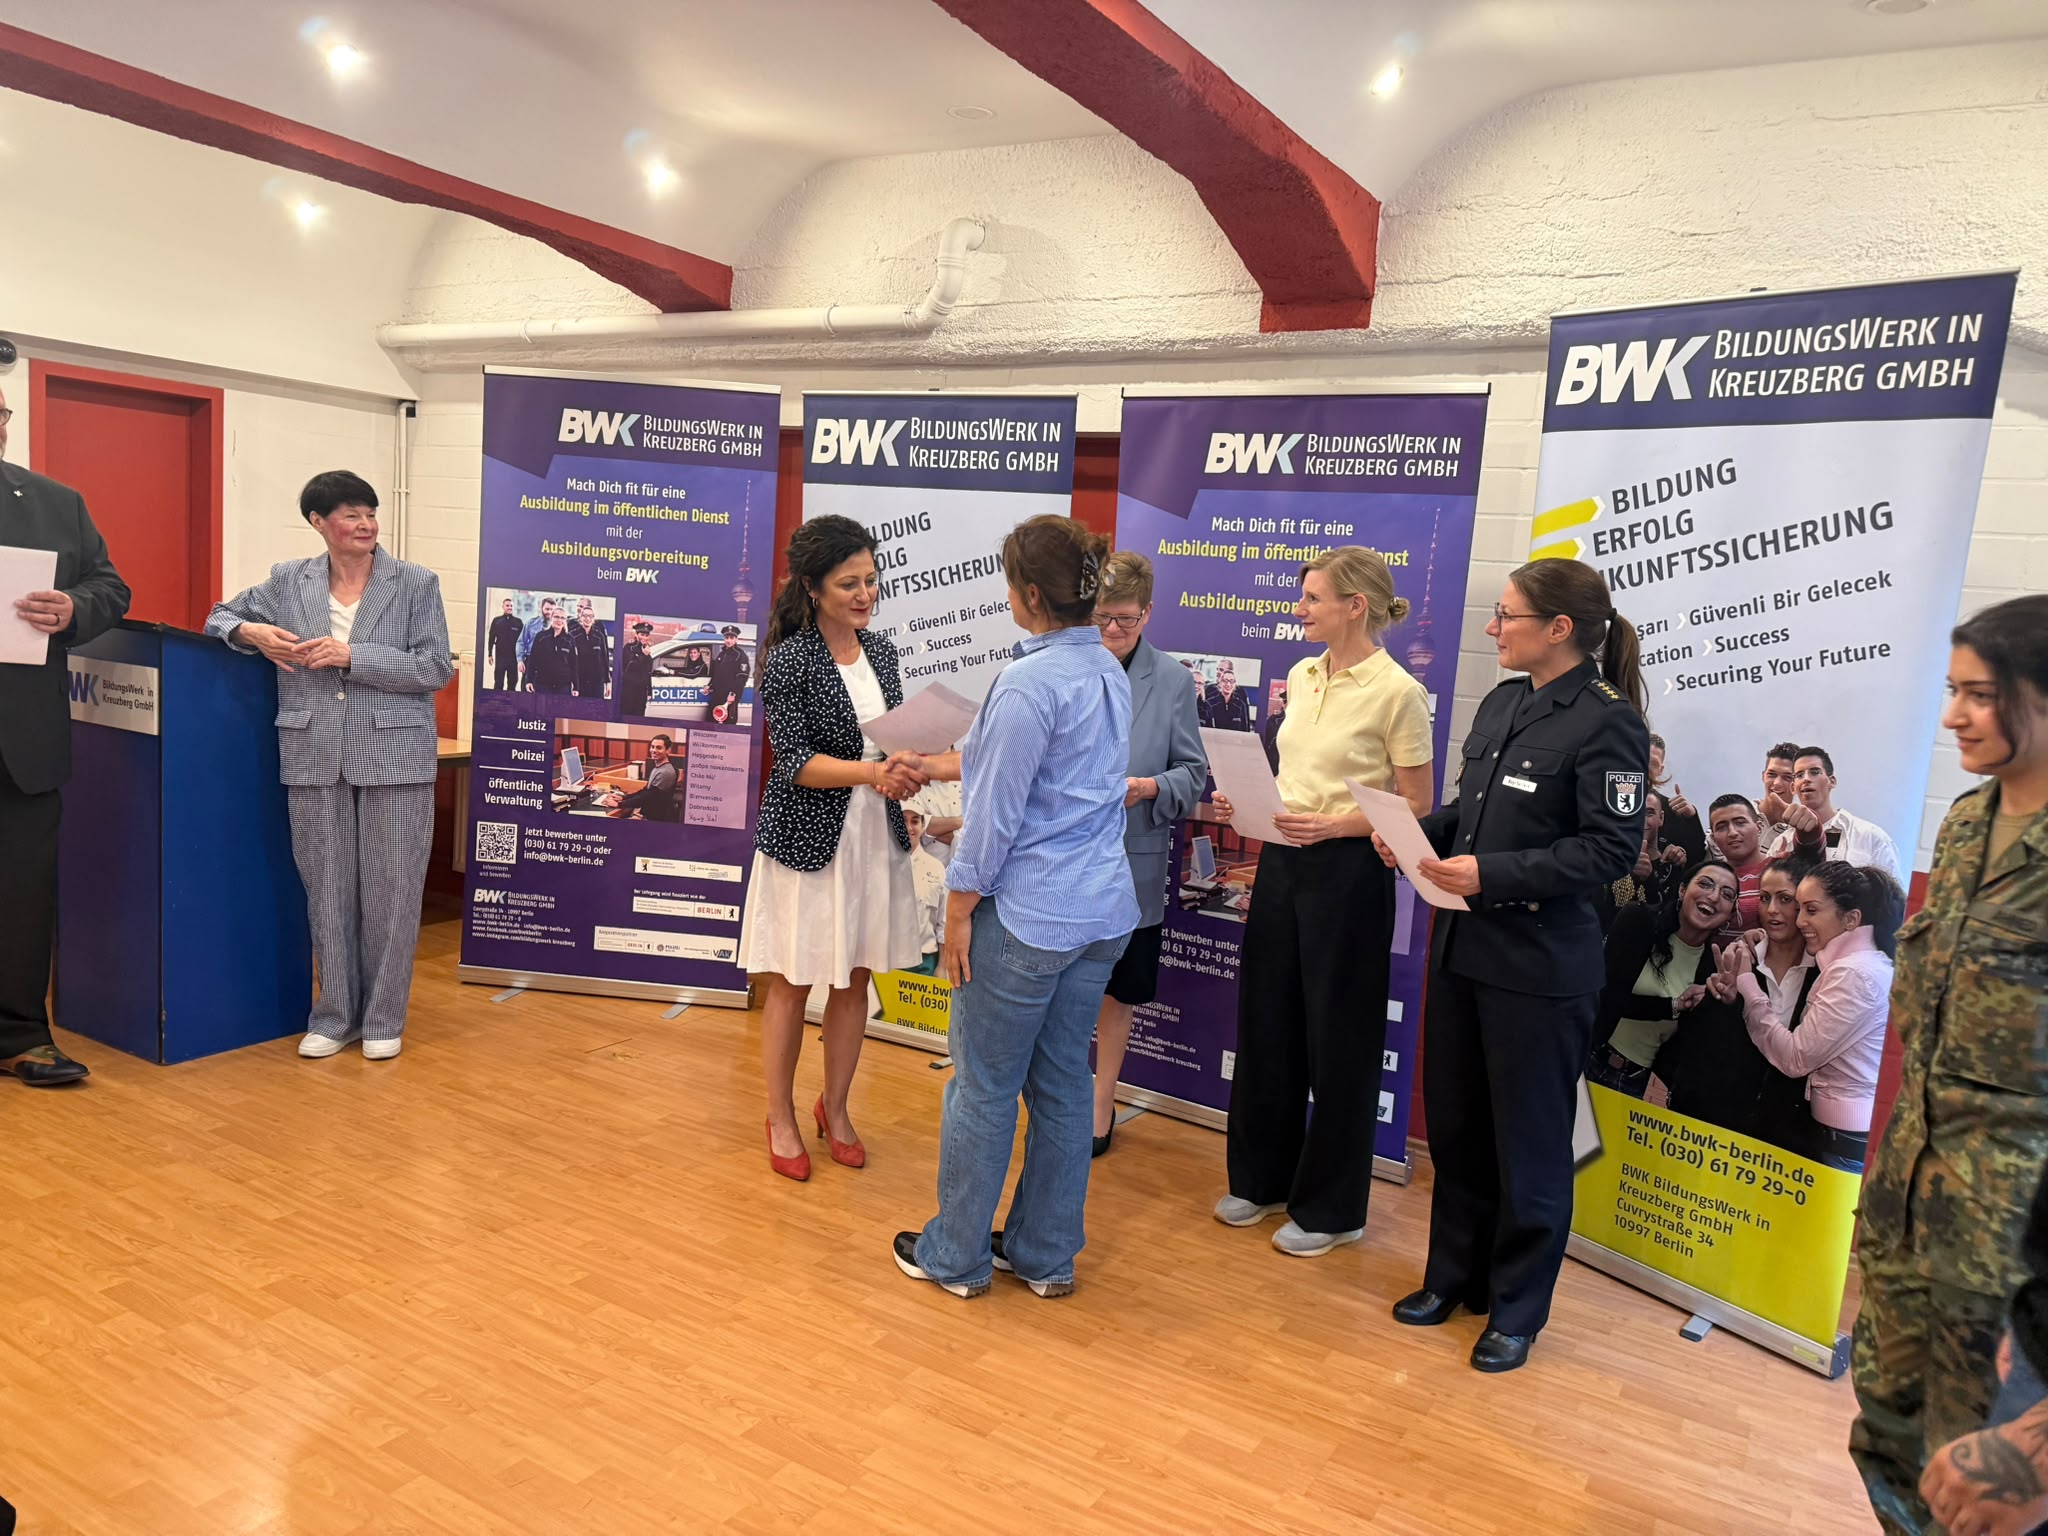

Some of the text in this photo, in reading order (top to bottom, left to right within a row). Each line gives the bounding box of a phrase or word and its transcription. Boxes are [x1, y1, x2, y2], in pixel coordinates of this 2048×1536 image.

[1946, 314, 1983, 344] IN
[1555, 335, 1712, 406] BWK
[558, 408, 641, 447] BWK
[749, 426, 763, 440] IN
[1043, 423, 1061, 443] IN
[811, 418, 908, 467] BWK
[1204, 432, 1305, 475] BWK
[1442, 437, 1461, 455] IN
[567, 478, 686, 500] Mach Dich fit für eine
[1612, 458, 1737, 515] BILDUNG
[520, 495, 730, 525] Ausbildung im öffentlichen Dienst
[606, 525, 643, 540] mit der
[871, 511, 931, 543] LDUNG
[1212, 516, 1354, 536] Mach Dich fit für eine
[1592, 509, 1694, 557] ERFOLG
[541, 540, 709, 570] Ausbildungsvorbereitung
[1158, 538, 1237, 562] Ausbildung
[1241, 543, 1259, 560] im
[1599, 501, 1894, 592] KUNFTSSICHERUNG
[875, 547, 908, 572] OLG
[597, 567, 659, 584] beim BWK
[1255, 571, 1298, 588] mit der
[1179, 591, 1300, 616] Ausbildungsvor
[1637, 570, 1893, 641] şarı Güvenli Bir Gelecek
[909, 610, 956, 632] Güvenli
[960, 608, 976, 622] Bir
[979, 601, 1010, 617] Gelec
[926, 633, 972, 652] Success
[1241, 622, 1306, 641] beim BW
[1639, 626, 1790, 667] cation Success
[904, 647, 1013, 679] Securing Your Futu
[1675, 643, 1891, 691] Securing Your Future
[69, 671, 99, 707] WK
[103, 680, 154, 697] BildungsWerk in
[652, 689, 698, 700] POLIZEI
[102, 694, 154, 713] Kreuzberg GmbH
[517, 718, 547, 731] Justiz
[511, 749, 545, 762] Polizei
[488, 777, 544, 793] öffentliche
[1609, 775, 1642, 783] POLIZEI
[484, 793, 543, 810] Verwaltung
[524, 827, 607, 843] Jetzt bewerben unter
[524, 838, 545, 849] (030)
[547, 840, 556, 850] 61
[559, 841, 569, 851] 79
[594, 845, 612, 855] oder
[524, 850, 604, 867] info@bwk-berlin.de
[473, 888, 507, 905] BWK
[697, 907, 721, 915] BERLIN
[1171, 928, 1213, 947] bewerben
[1215, 940, 1240, 952] unter
[1172, 943, 1184, 954] 61
[1186, 946, 1197, 957] 79
[1223, 956, 1240, 967] ode
[1159, 955, 1235, 980] o@bwk-berlin.de
[898, 991, 948, 1013] Tel. (030)
[1132, 1005, 1160, 1018] REUZBERG
[1627, 1125, 1653, 1150] Tel.
[1660, 1137, 1704, 1169] (030)
[1710, 1158, 1729, 1176] 61
[1735, 1166, 1756, 1185] 79
[1629, 1109, 1815, 1188] www.bwk-berlin.de
[1619, 1180, 1734, 1236] Kreuzberg GmbH
[1621, 1163, 1771, 1232] BWK BildungsWerk in
[1617, 1198, 1715, 1248] Cuvrystraße 34
[1614, 1214, 1694, 1259] 10997 Berlin
